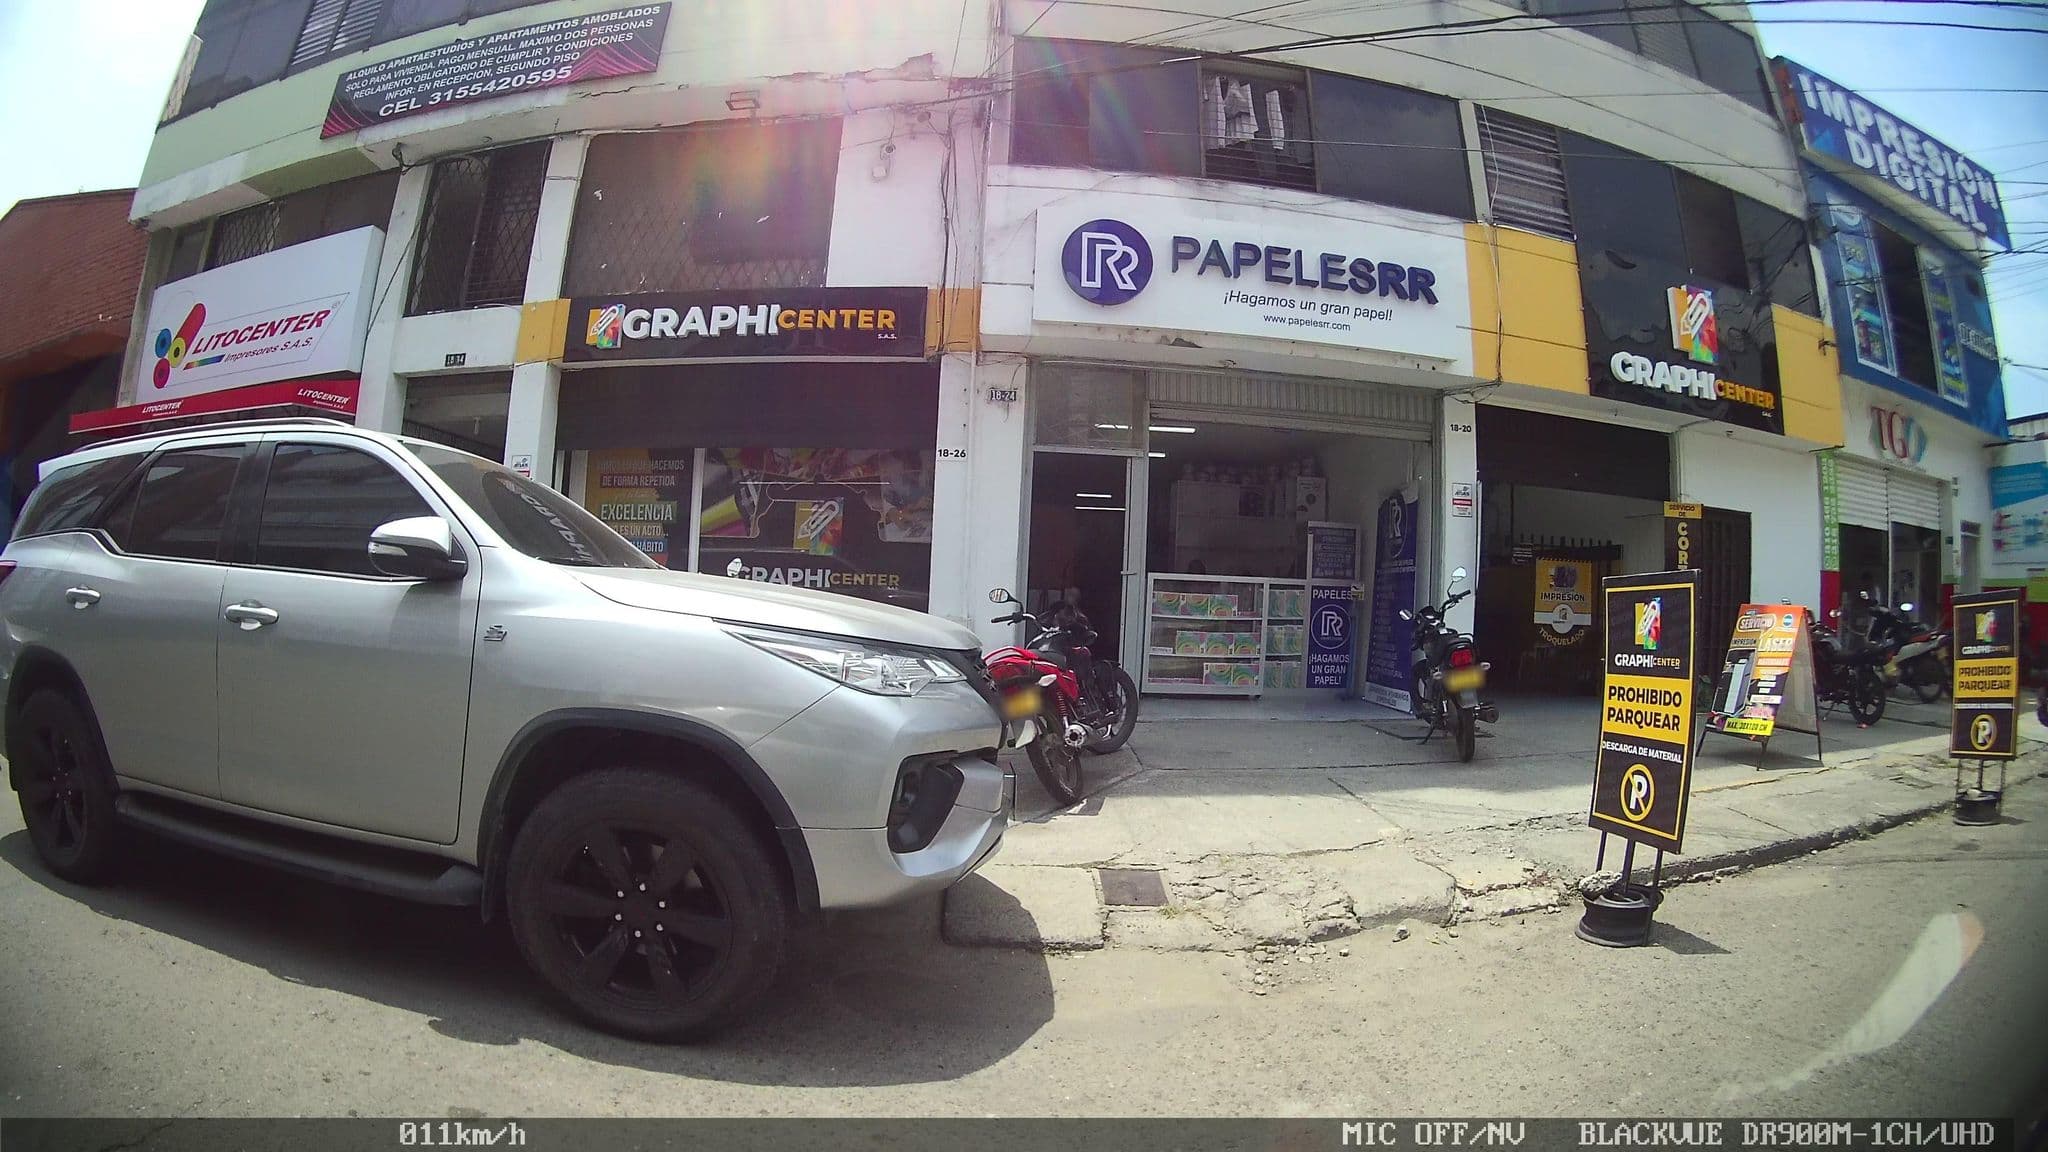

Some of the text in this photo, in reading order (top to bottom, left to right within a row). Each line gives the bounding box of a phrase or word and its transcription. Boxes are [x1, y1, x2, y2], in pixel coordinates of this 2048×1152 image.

[345, 80, 368, 93] SOLO
[369, 75, 392, 86] PARA
[437, 55, 464, 67] PAGO
[519, 34, 561, 48] MAXIMO
[564, 29, 587, 40] DOS
[590, 18, 653, 35] PERSONAS
[346, 64, 385, 81] ALQUILO
[387, 40, 474, 69] APARTAESTUDIOS
[487, 18, 580, 47] APARTAMENTOS
[581, 6, 660, 25] AMOBLADOS
[353, 32, 634, 100] REGLAMENTO OBLIGATORIO DE CUMPLIR Y CONDICIONES
[418, 82, 431, 93] EN
[496, 57, 550, 74] SEGUNDO
[553, 52, 580, 63] PISO
[379, 66, 572, 117] CEL 3155420595
[1845, 128, 1987, 233] DIGITAL
[1171, 235, 1439, 305] PAPELESRR
[1224, 290, 1393, 321] ¡Hagamos un gran papel!
[192, 309, 331, 354] LITOCENTER
[1264, 314, 1351, 331] www.papelesrr.com
[224, 337, 313, 363] Impresores S.A.S.
[297, 389, 349, 404] LITOCENTER
[991, 390, 1015, 400] 18-24
[1450, 424, 1471, 432] 18-20
[937, 449, 966, 458] 18-26
[613, 475, 638, 486] FORMA
[639, 475, 675, 486] REPETIDA
[601, 503, 673, 521] EXCELENCIA
[1311, 665, 1346, 674] UN GRAN
[1608, 685, 1682, 707] PROHIBIDO
[1607, 706, 1680, 731] PARQUEAR
[1601, 741, 1683, 763] DESCARGA DE MATERIAL
